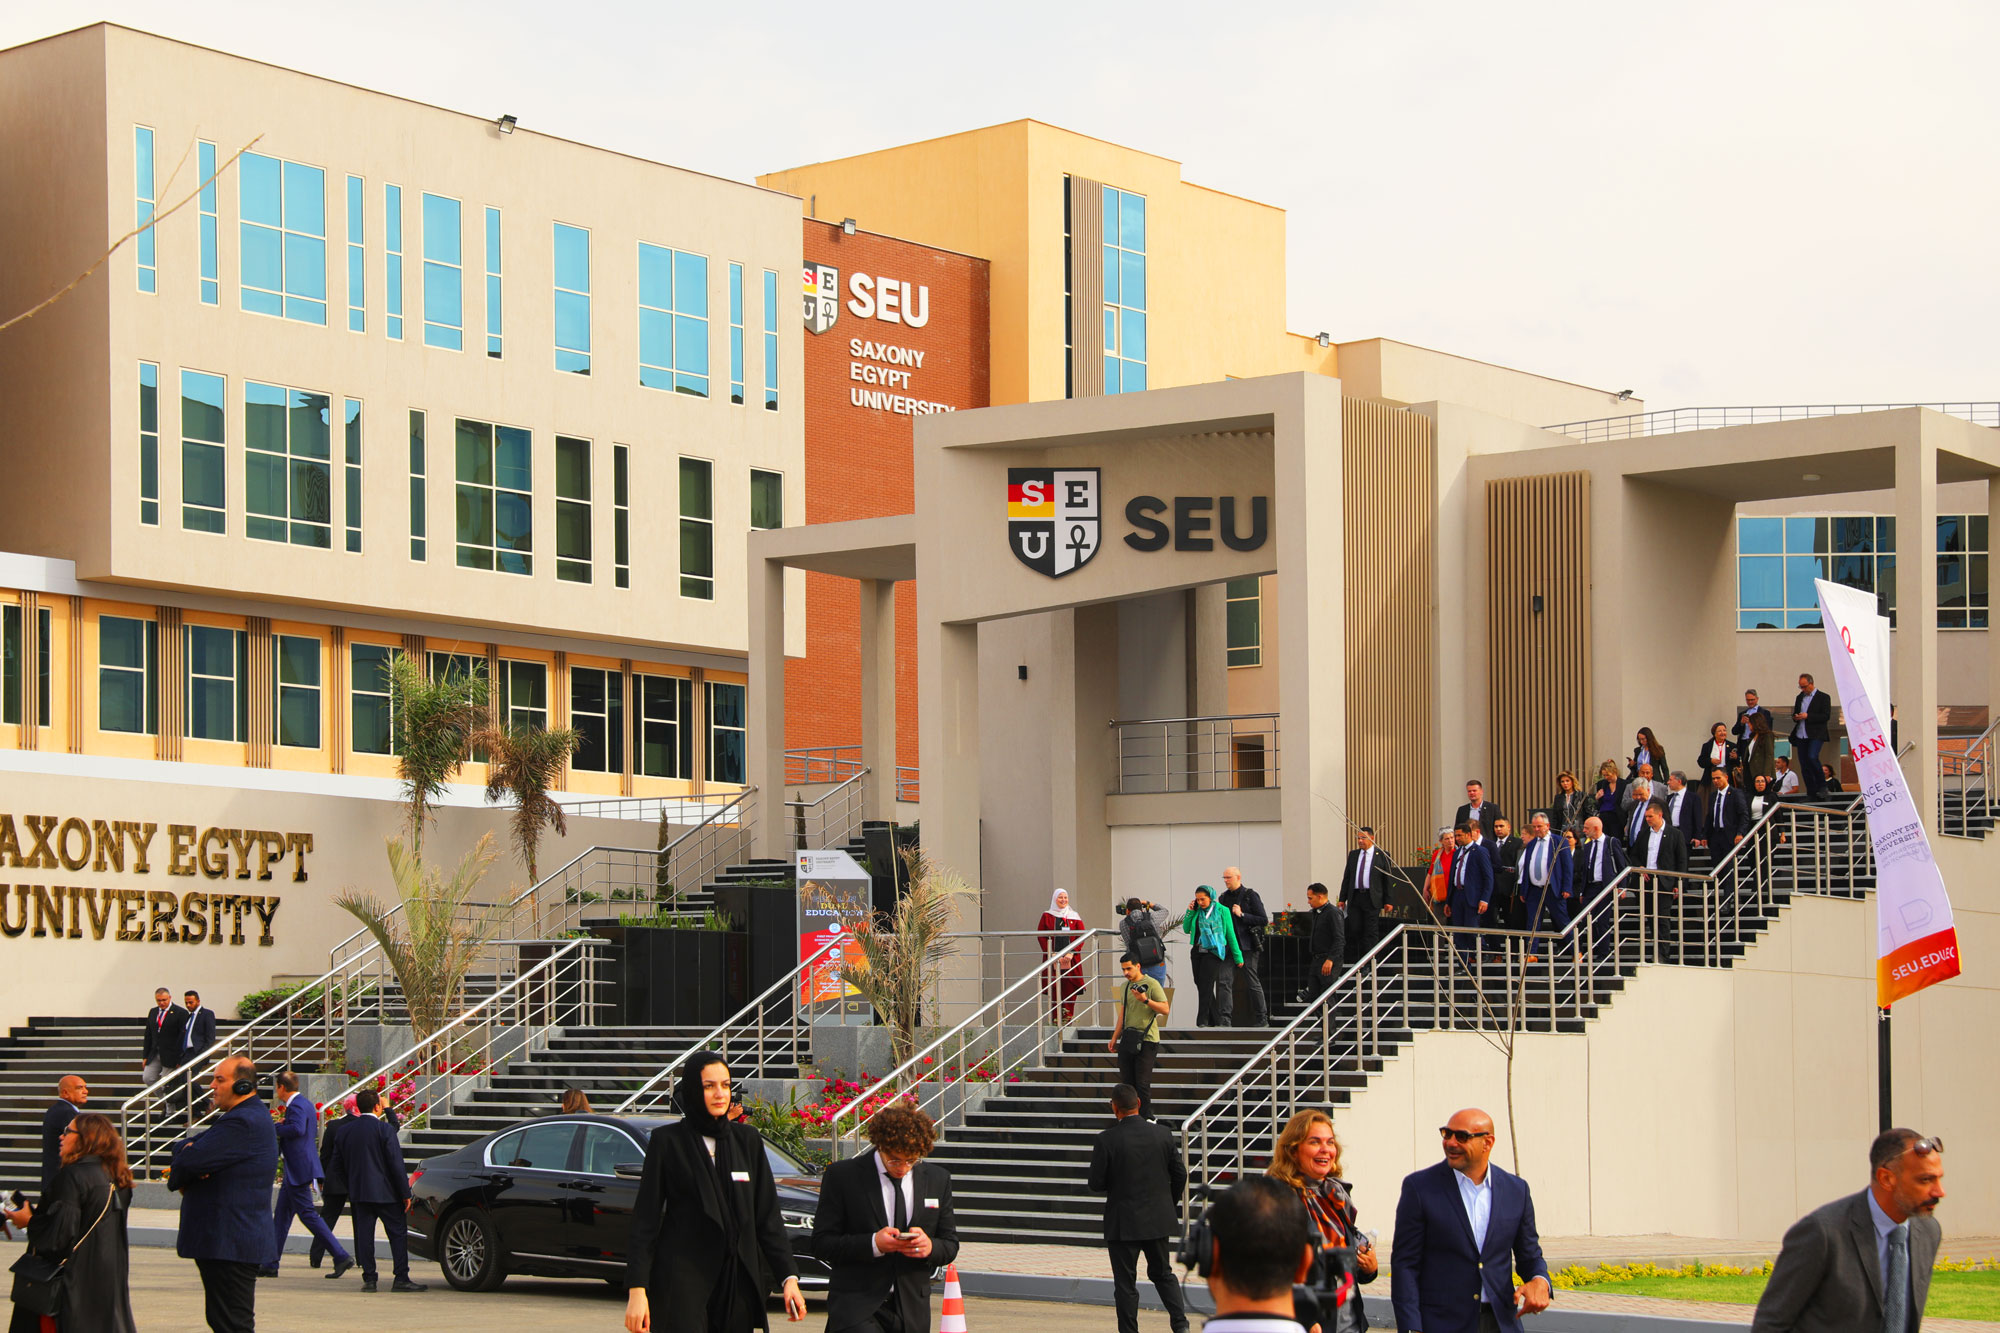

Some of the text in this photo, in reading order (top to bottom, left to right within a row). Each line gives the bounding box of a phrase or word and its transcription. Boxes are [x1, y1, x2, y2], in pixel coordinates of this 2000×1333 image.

[822, 272, 834, 291] E
[847, 272, 929, 328] SEU
[850, 338, 925, 369] SAXONY
[850, 362, 912, 389] EGYPT
[1021, 480, 1089, 508] S E
[1123, 495, 1268, 552] SEU
[1019, 531, 1049, 559] U
[0, 813, 314, 883] AXONY EGYPT
[1875, 827, 1903, 848] SAXONY
[1878, 830, 1920, 856] UNIVERSITY
[0, 883, 281, 946] UNIVERSITY
